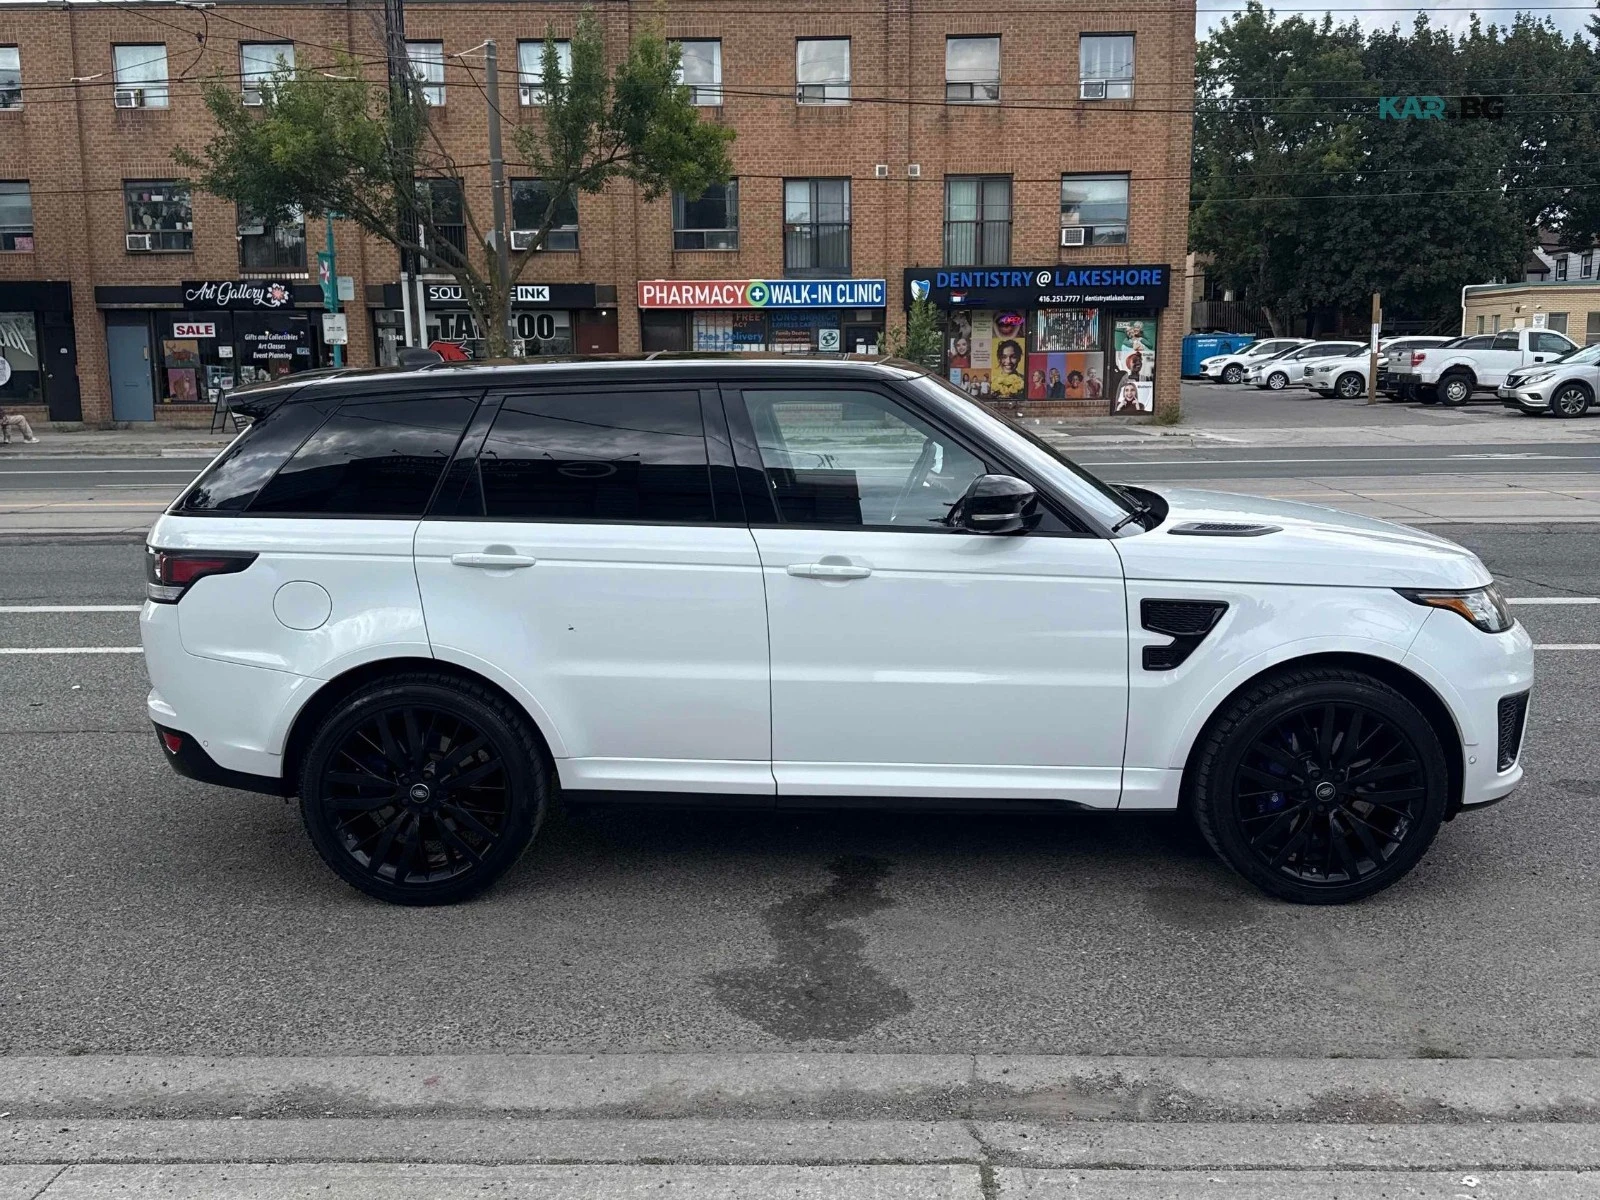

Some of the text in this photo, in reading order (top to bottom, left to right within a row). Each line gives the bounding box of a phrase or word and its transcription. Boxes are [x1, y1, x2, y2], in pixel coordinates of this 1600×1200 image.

[936, 269, 1162, 288] DENTISTRY @ LAKESHORE
[186, 281, 279, 308] Art Gallery
[520, 287, 547, 299] INK
[643, 283, 882, 304] PHARMACY WALK-IN CLINIC
[1085, 294, 1144, 303] dentistryatlakeshore.com
[736, 313, 761, 321] FREE
[176, 325, 214, 335] SALE
[435, 313, 555, 340] TAOO
[245, 333, 257, 341] Gifts
[269, 333, 298, 341] Collectibles
[699, 331, 764, 343] Free Delivery
[268, 352, 293, 360] Planning
